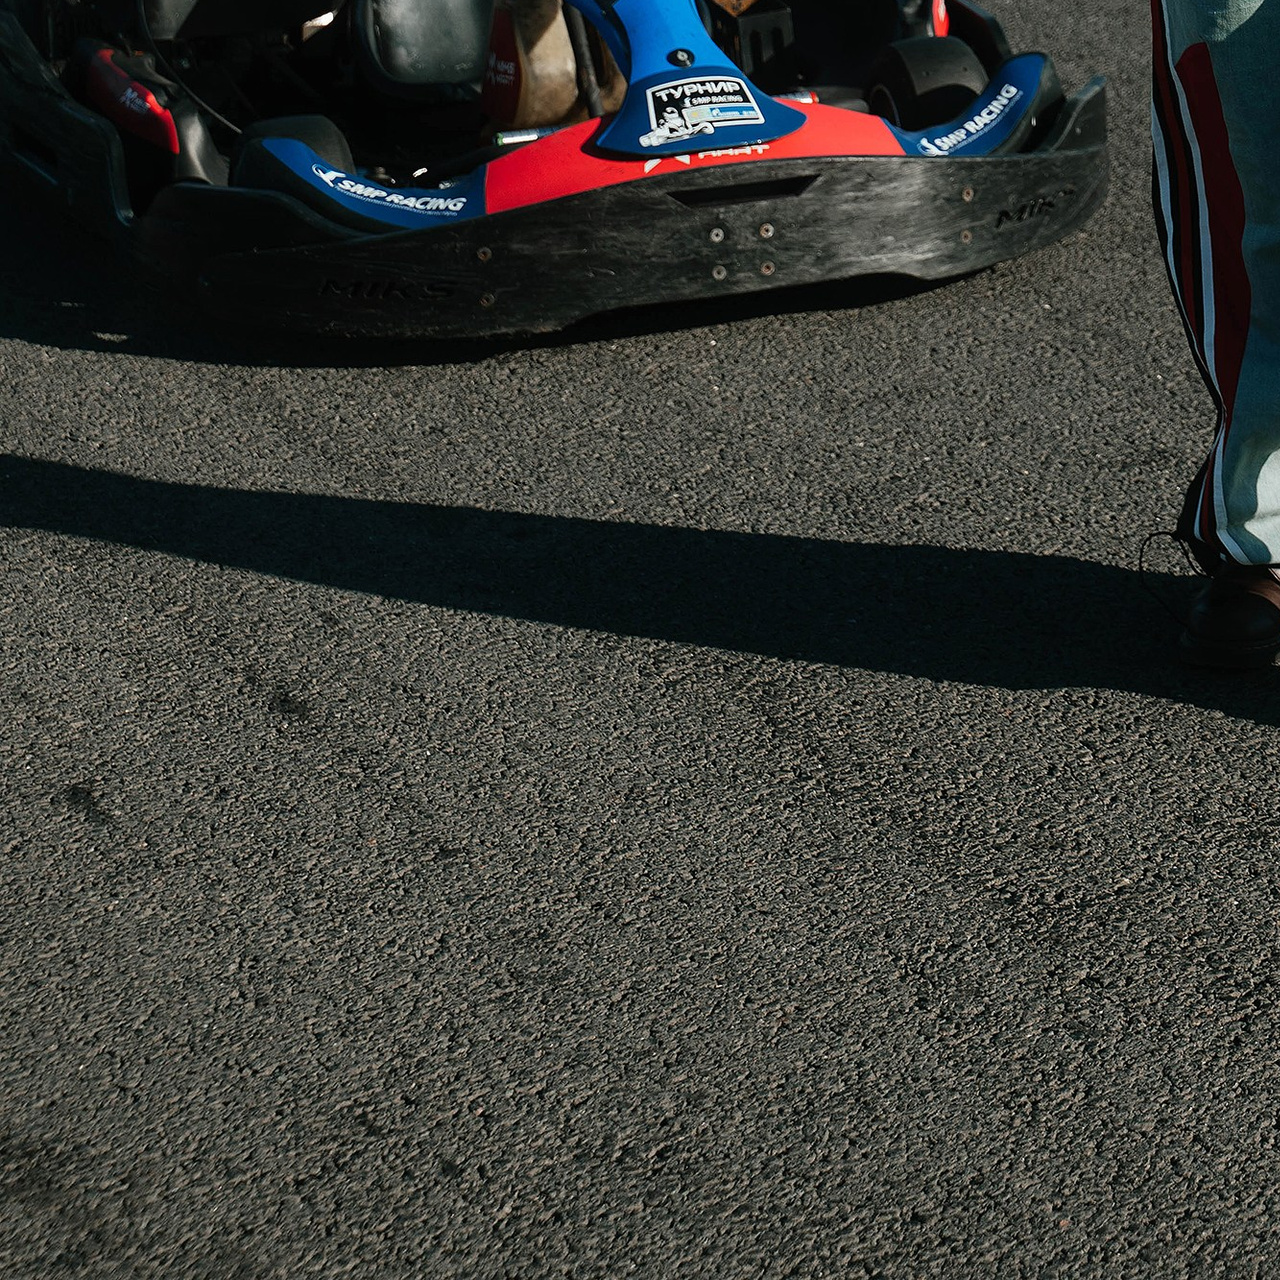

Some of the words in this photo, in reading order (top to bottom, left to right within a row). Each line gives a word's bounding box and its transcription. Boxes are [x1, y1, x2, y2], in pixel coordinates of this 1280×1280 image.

[654, 80, 741, 102] ТУРНИР
[691, 96, 711, 106] SMP
[711, 94, 744, 104] RACING
[934, 128, 967, 151] SMP
[963, 83, 1018, 134] RACING
[337, 179, 388, 199] SMP
[385, 193, 468, 212] RACING
